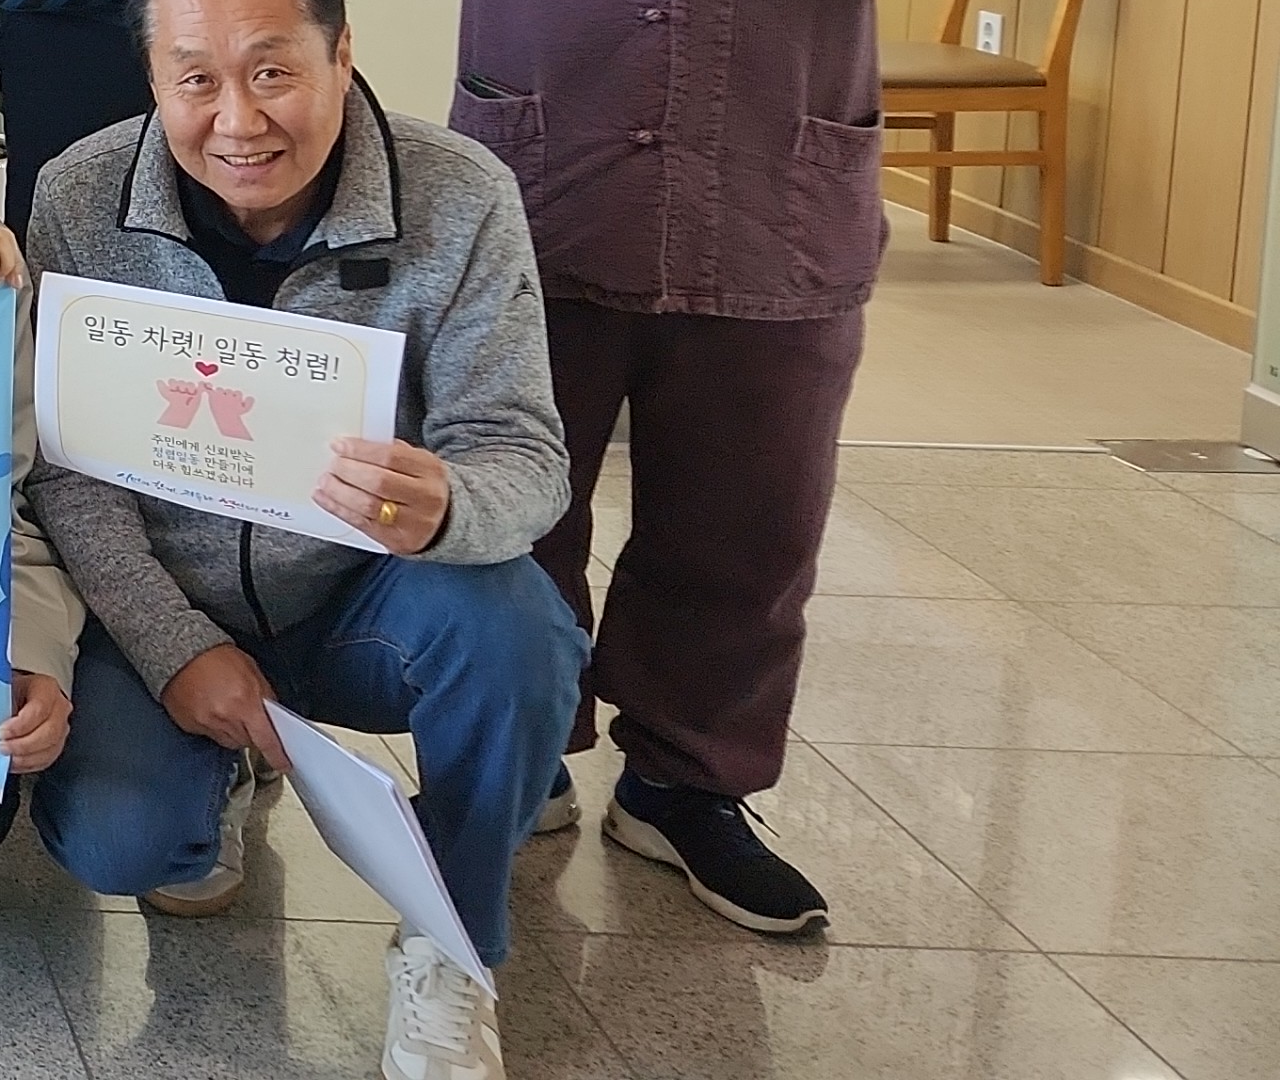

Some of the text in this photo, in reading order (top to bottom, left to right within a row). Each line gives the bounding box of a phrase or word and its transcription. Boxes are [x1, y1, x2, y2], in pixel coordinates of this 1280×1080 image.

[85, 316, 339, 381] 일동 차렷! 일동 청렴!
[151, 434, 255, 463] 주민에게 신뢰받는
[152, 447, 253, 476] 청렴일동 만들기에
[153, 459, 254, 488] 더욱 힘쓰겠습니다
